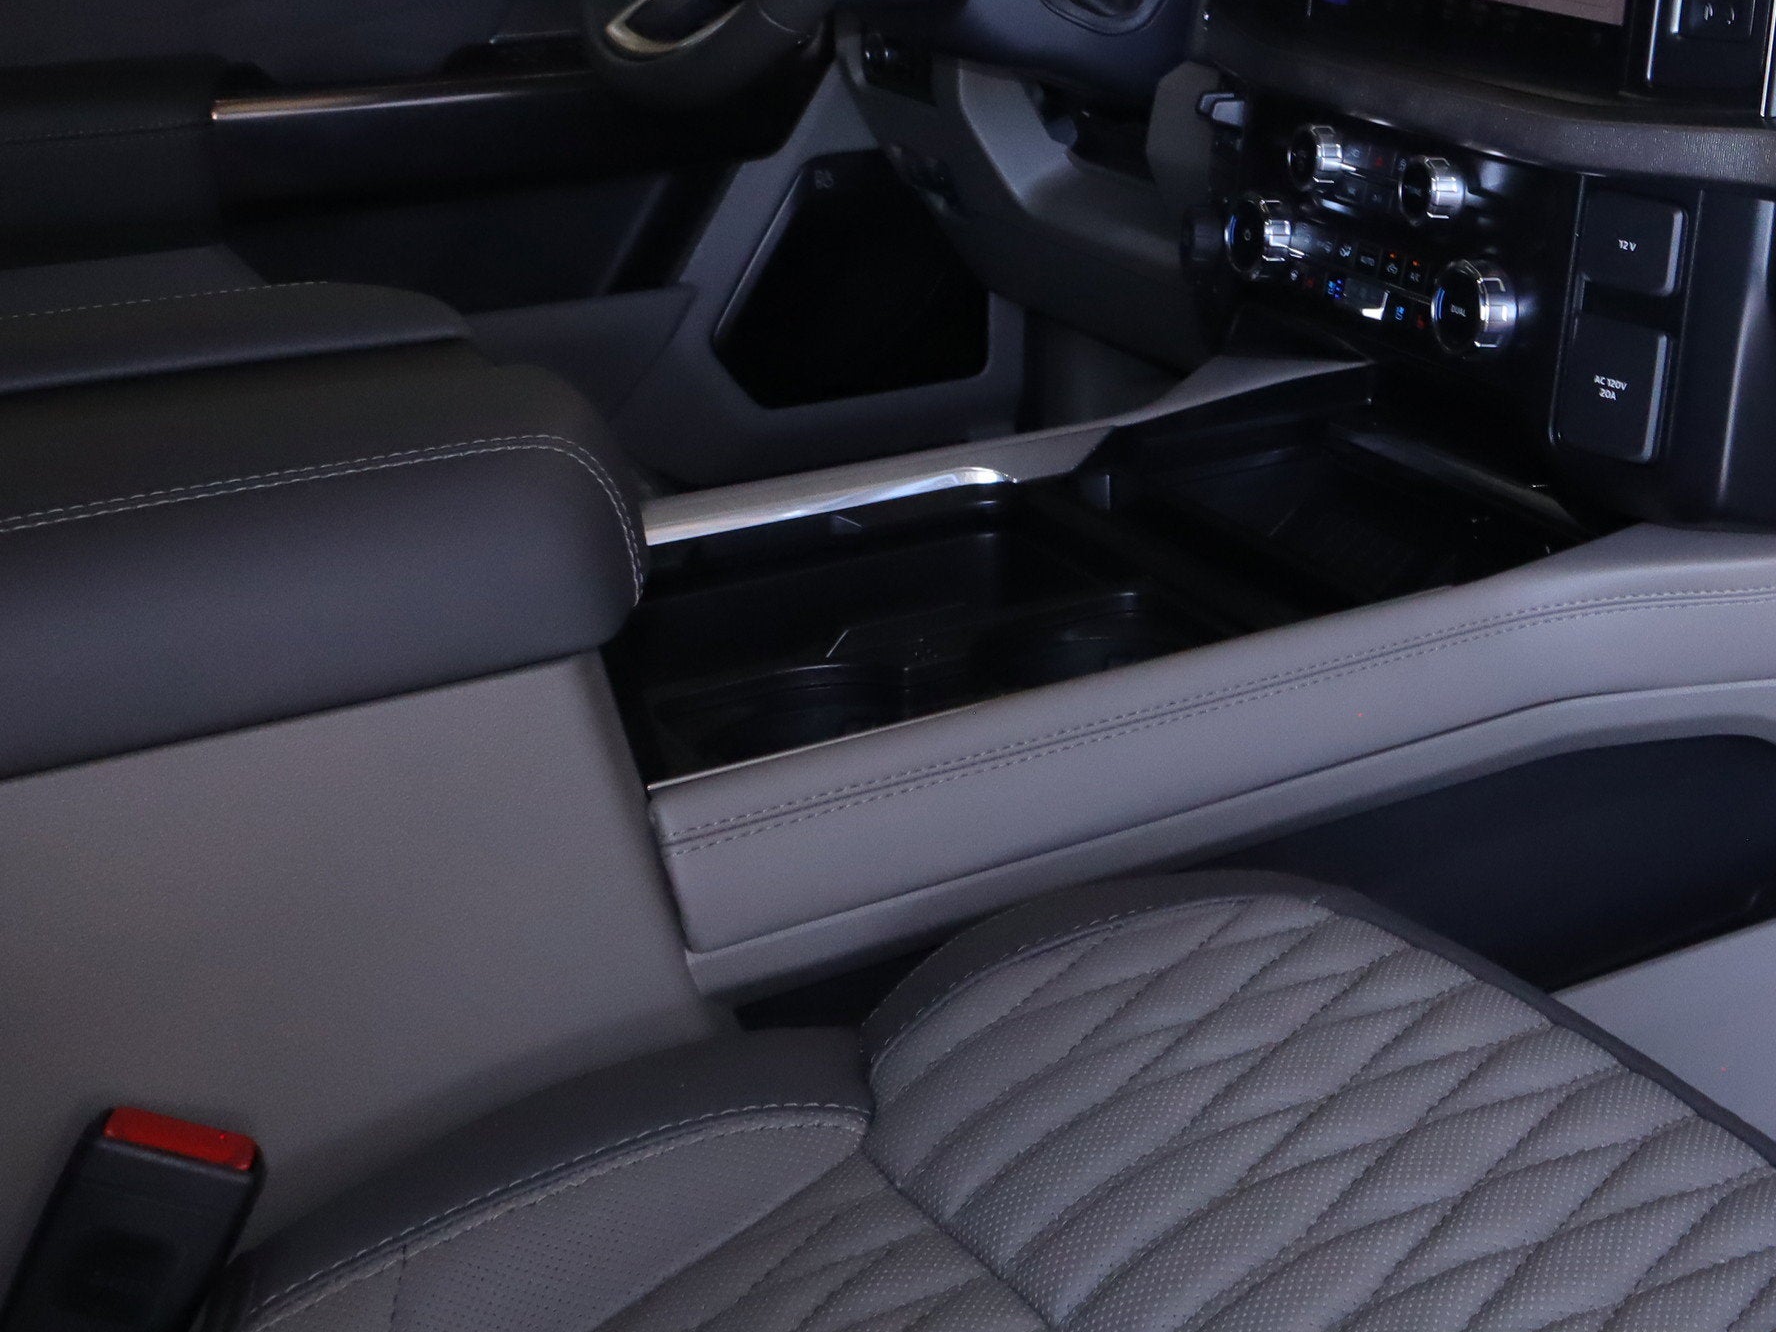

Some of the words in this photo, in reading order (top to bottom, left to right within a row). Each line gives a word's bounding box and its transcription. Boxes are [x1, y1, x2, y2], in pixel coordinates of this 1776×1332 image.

[1593, 374, 1606, 386] AC
[1606, 378, 1627, 391] 120V
[1598, 387, 1617, 400] 20A
